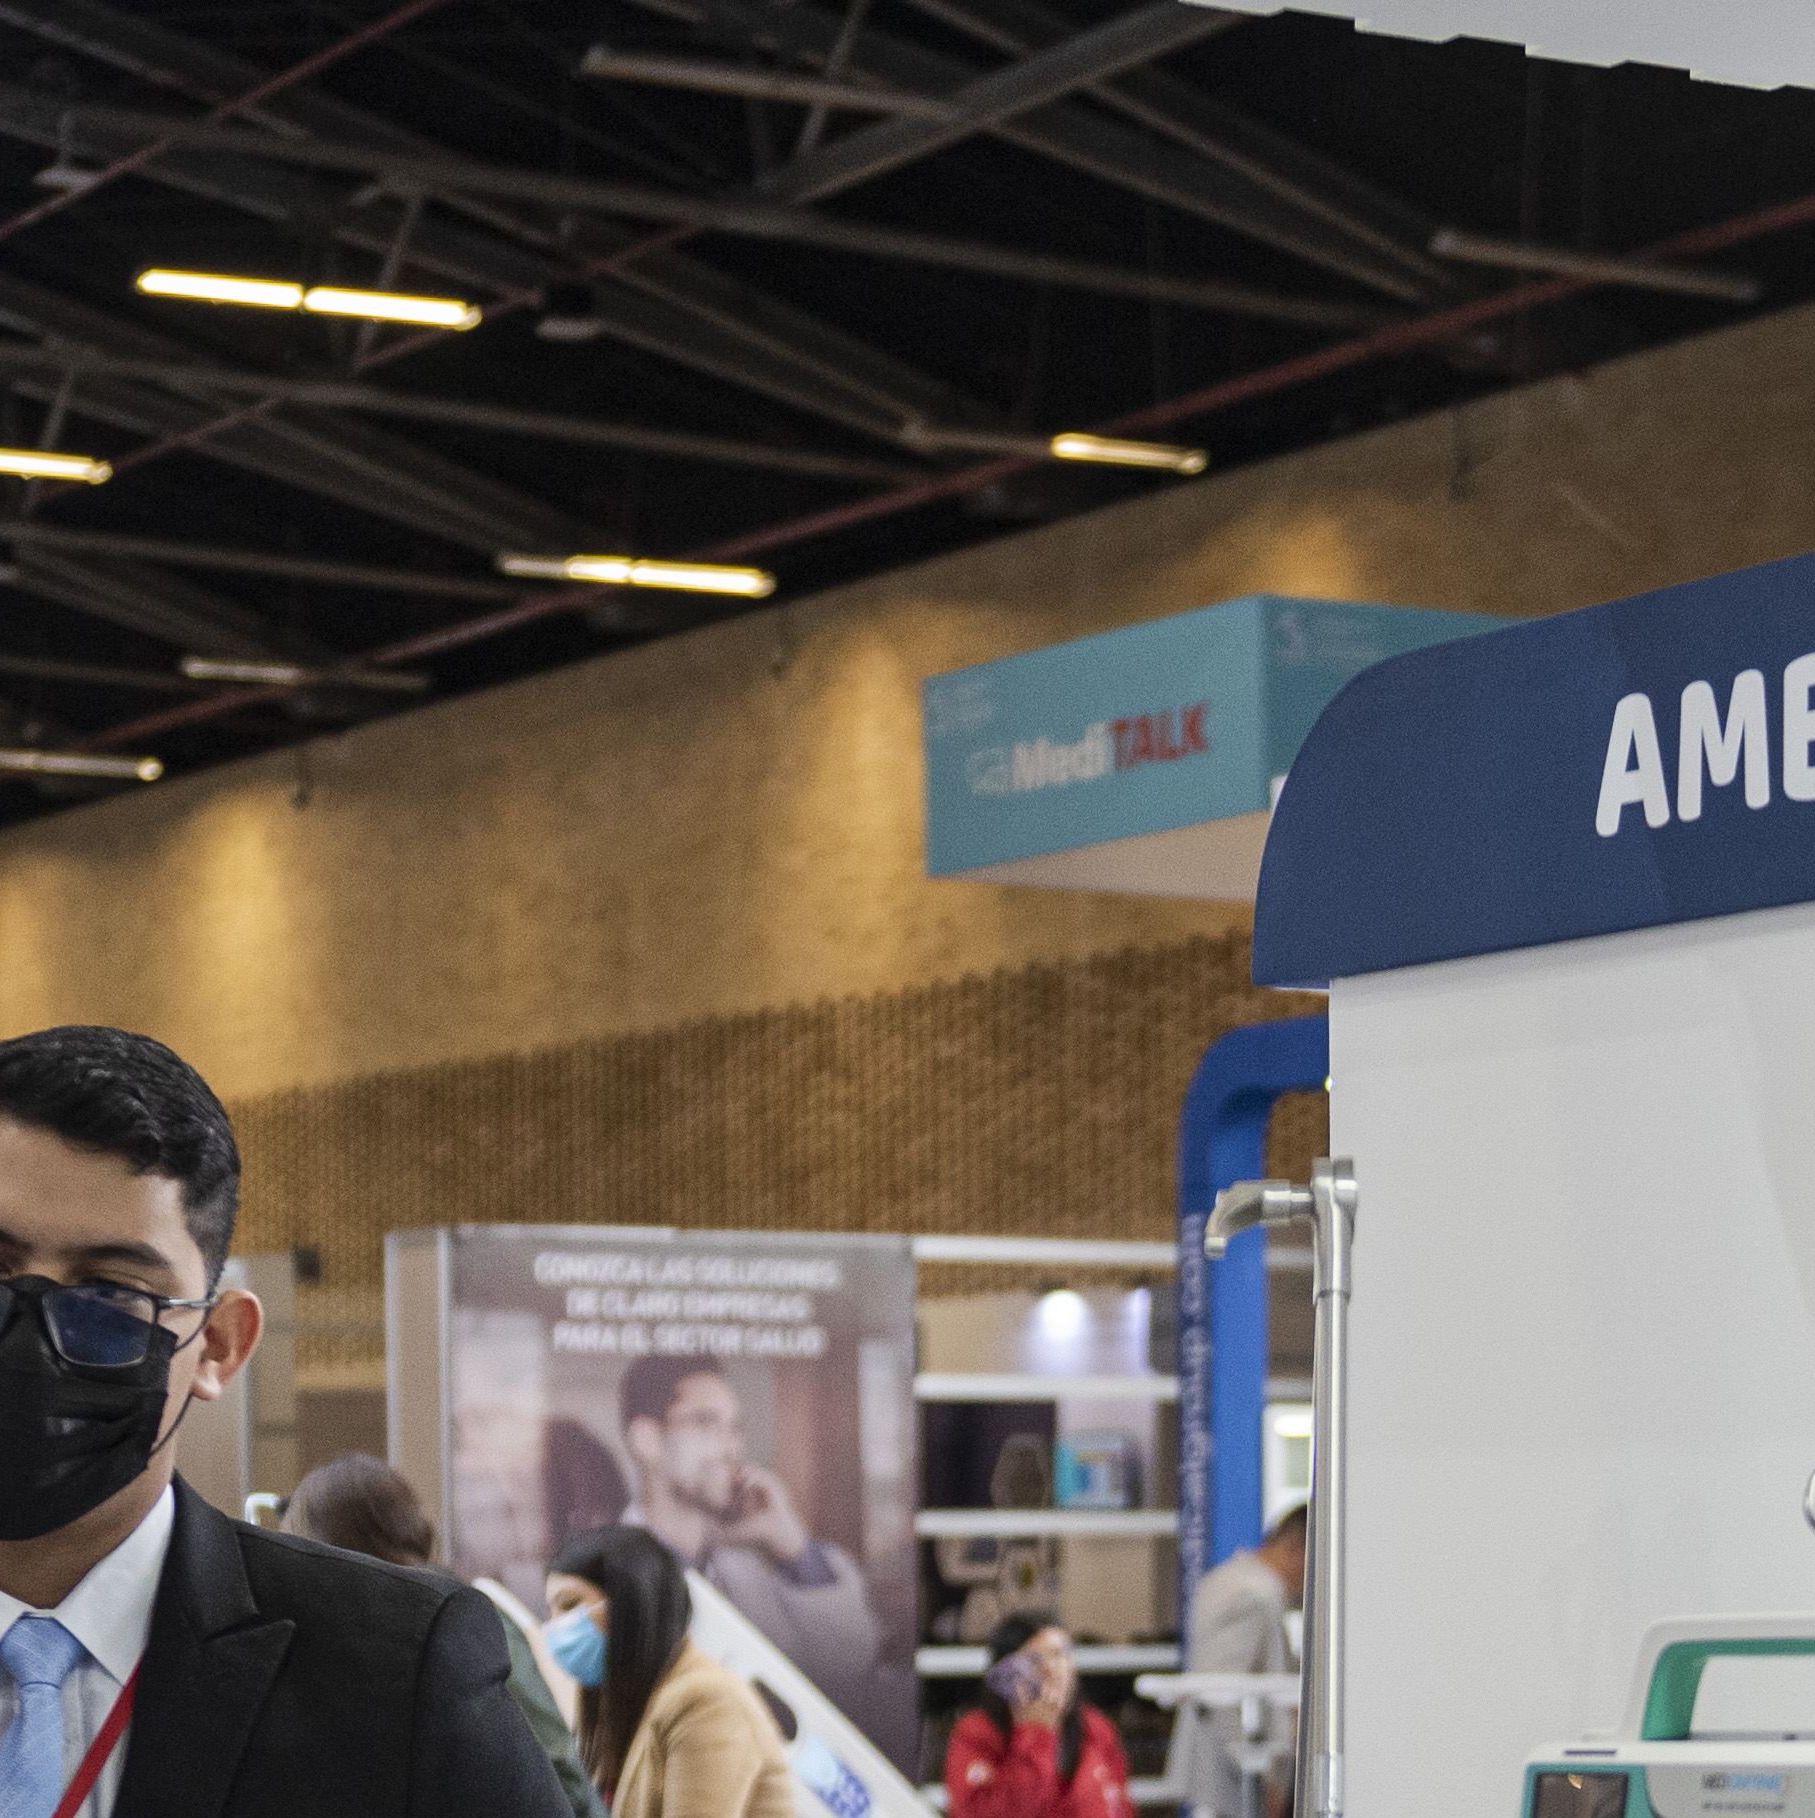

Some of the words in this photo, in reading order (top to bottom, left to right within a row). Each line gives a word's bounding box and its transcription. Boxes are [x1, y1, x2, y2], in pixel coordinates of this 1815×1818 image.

[534, 1252, 642, 1284] CONOZCA
[694, 1256, 842, 1289] SOLUCIONES
[683, 1290, 813, 1321] EMPRESAS
